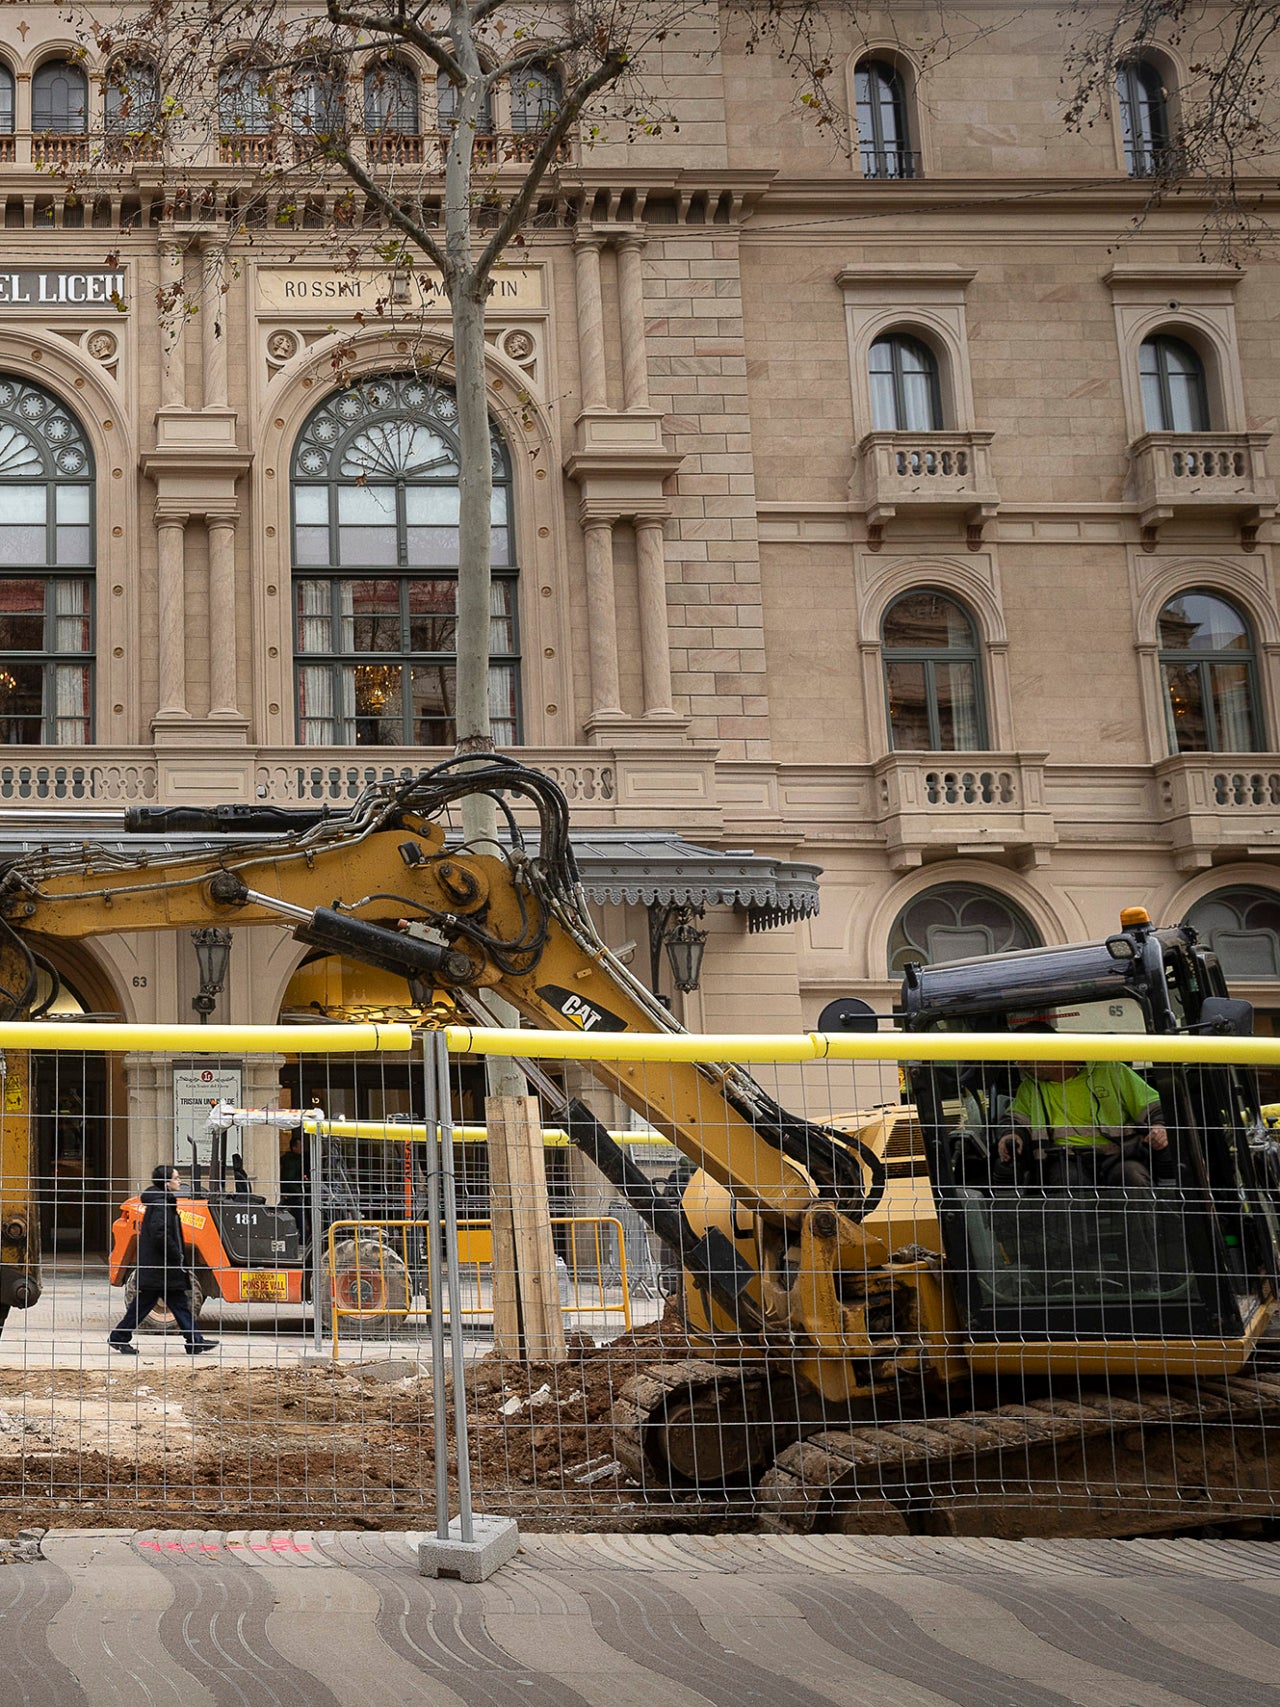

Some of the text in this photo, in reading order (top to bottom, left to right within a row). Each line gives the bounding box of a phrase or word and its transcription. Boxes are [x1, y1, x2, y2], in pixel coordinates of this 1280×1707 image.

[38, 275, 124, 302] LICEU
[285, 281, 361, 297] ROSSINI
[132, 976, 147, 988] 63
[561, 995, 603, 1031] CAT
[1108, 1005, 1124, 1018] 65
[180, 1097, 203, 1105] TRISTAN
[234, 1213, 258, 1225] 181
